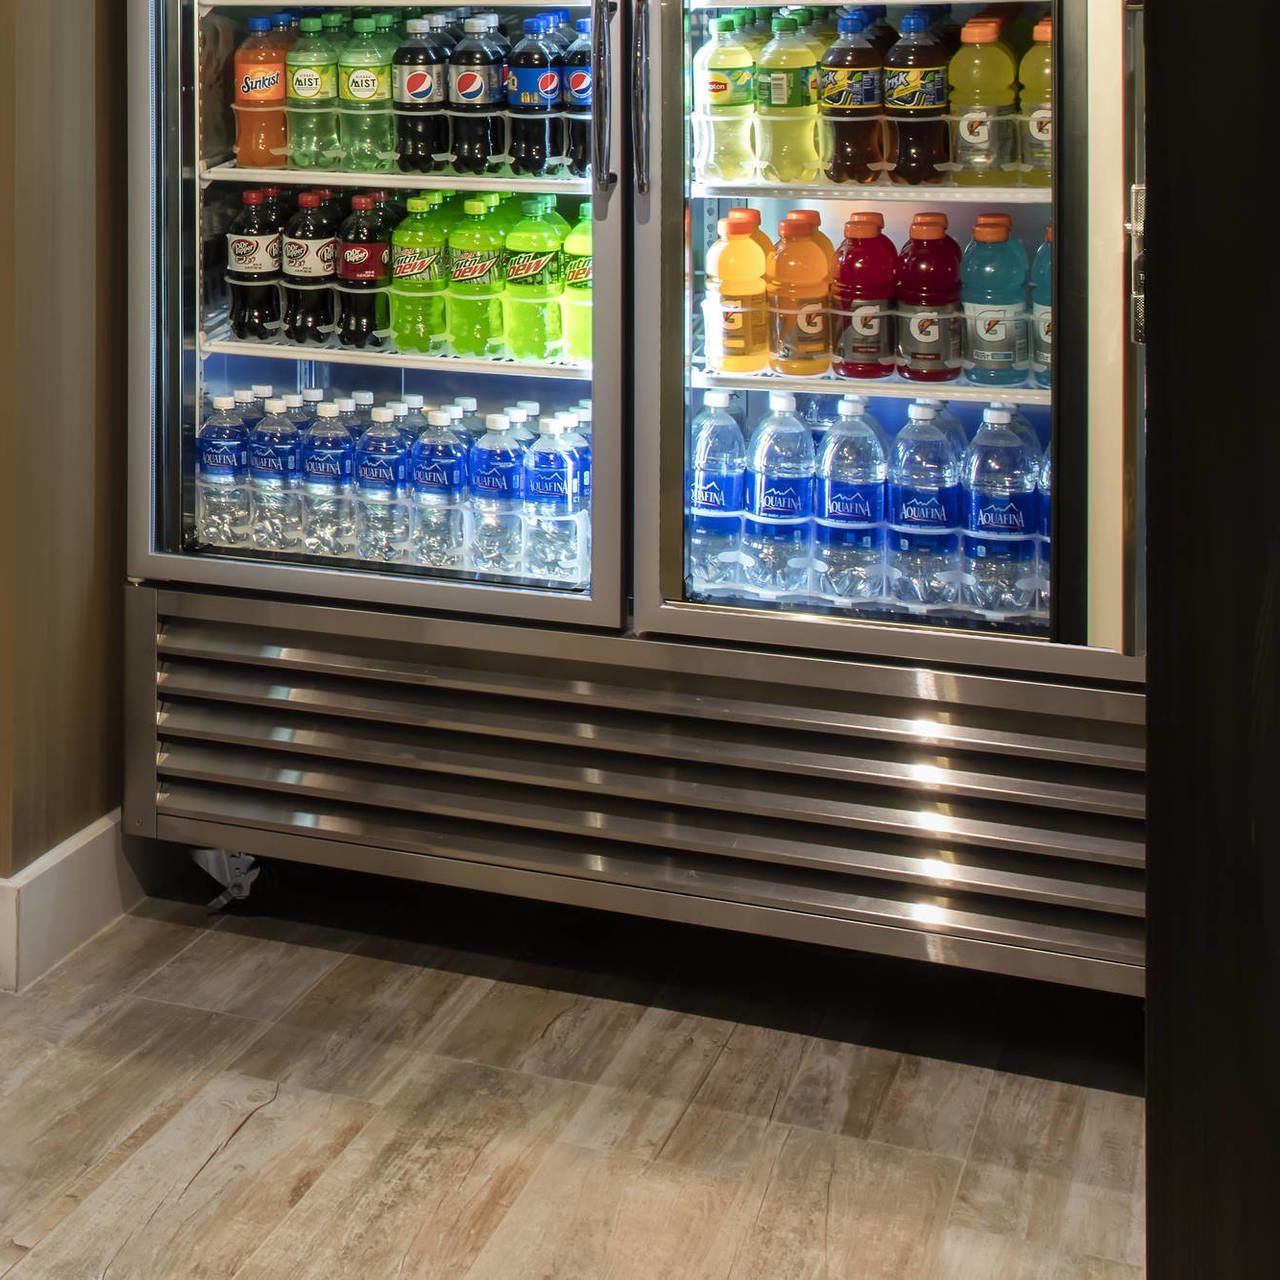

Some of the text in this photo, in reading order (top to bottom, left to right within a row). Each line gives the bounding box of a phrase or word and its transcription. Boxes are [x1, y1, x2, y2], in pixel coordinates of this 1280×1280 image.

[240, 72, 281, 94] Sunkist
[295, 77, 320, 87] MIST
[351, 78, 377, 89] MIST
[900, 503, 948, 522] AQUAFINA
[977, 508, 1025, 528] AQUAFINA
